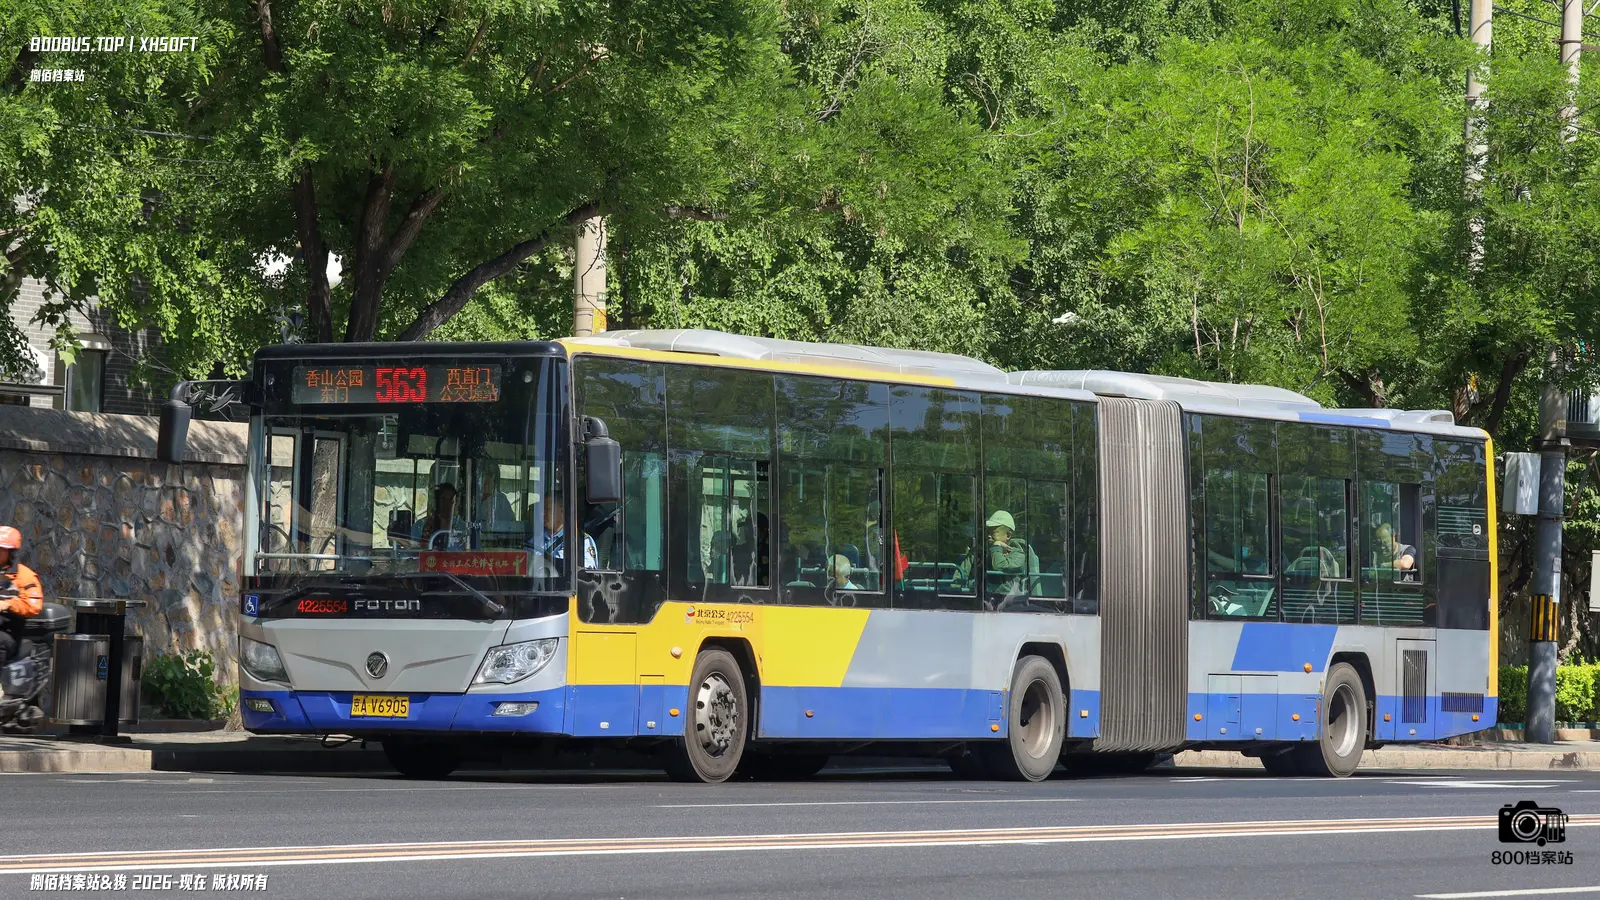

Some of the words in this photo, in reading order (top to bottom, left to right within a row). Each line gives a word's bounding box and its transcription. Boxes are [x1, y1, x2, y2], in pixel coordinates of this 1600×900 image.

[305, 369, 363, 387] 香山公园
[446, 367, 491, 385] 西直门
[375, 367, 427, 403] 563
[320, 386, 349, 403] 东门
[297, 600, 348, 613] 4225554
[354, 599, 420, 610] FOTON
[697, 609, 726, 619] 北京公交
